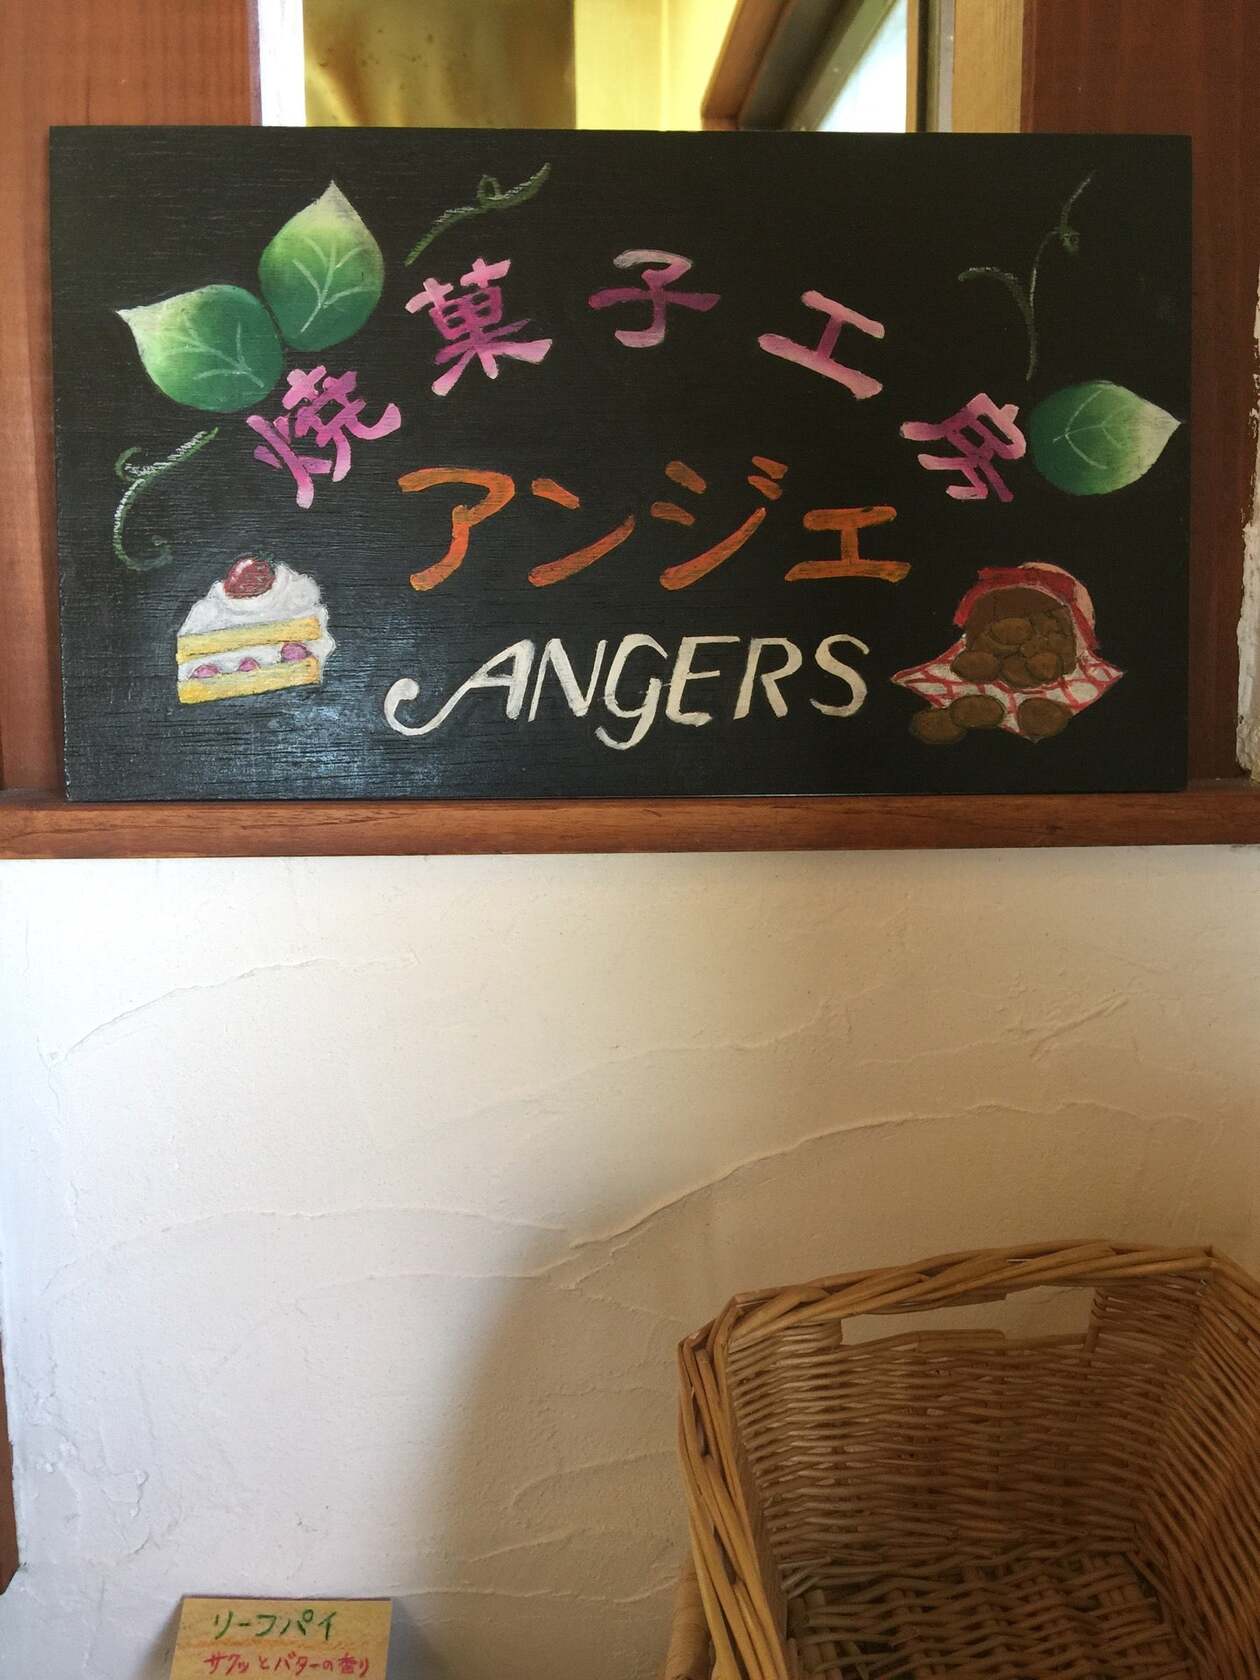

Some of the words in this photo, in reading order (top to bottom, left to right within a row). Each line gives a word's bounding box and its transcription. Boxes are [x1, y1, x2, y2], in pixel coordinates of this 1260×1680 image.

[247, 249, 1026, 509] 焼菓子工房
[384, 633, 870, 751] ANGERS
[213, 1608, 338, 1641] リーフパイ
[203, 1651, 370, 1678] サクッとバターの香り
